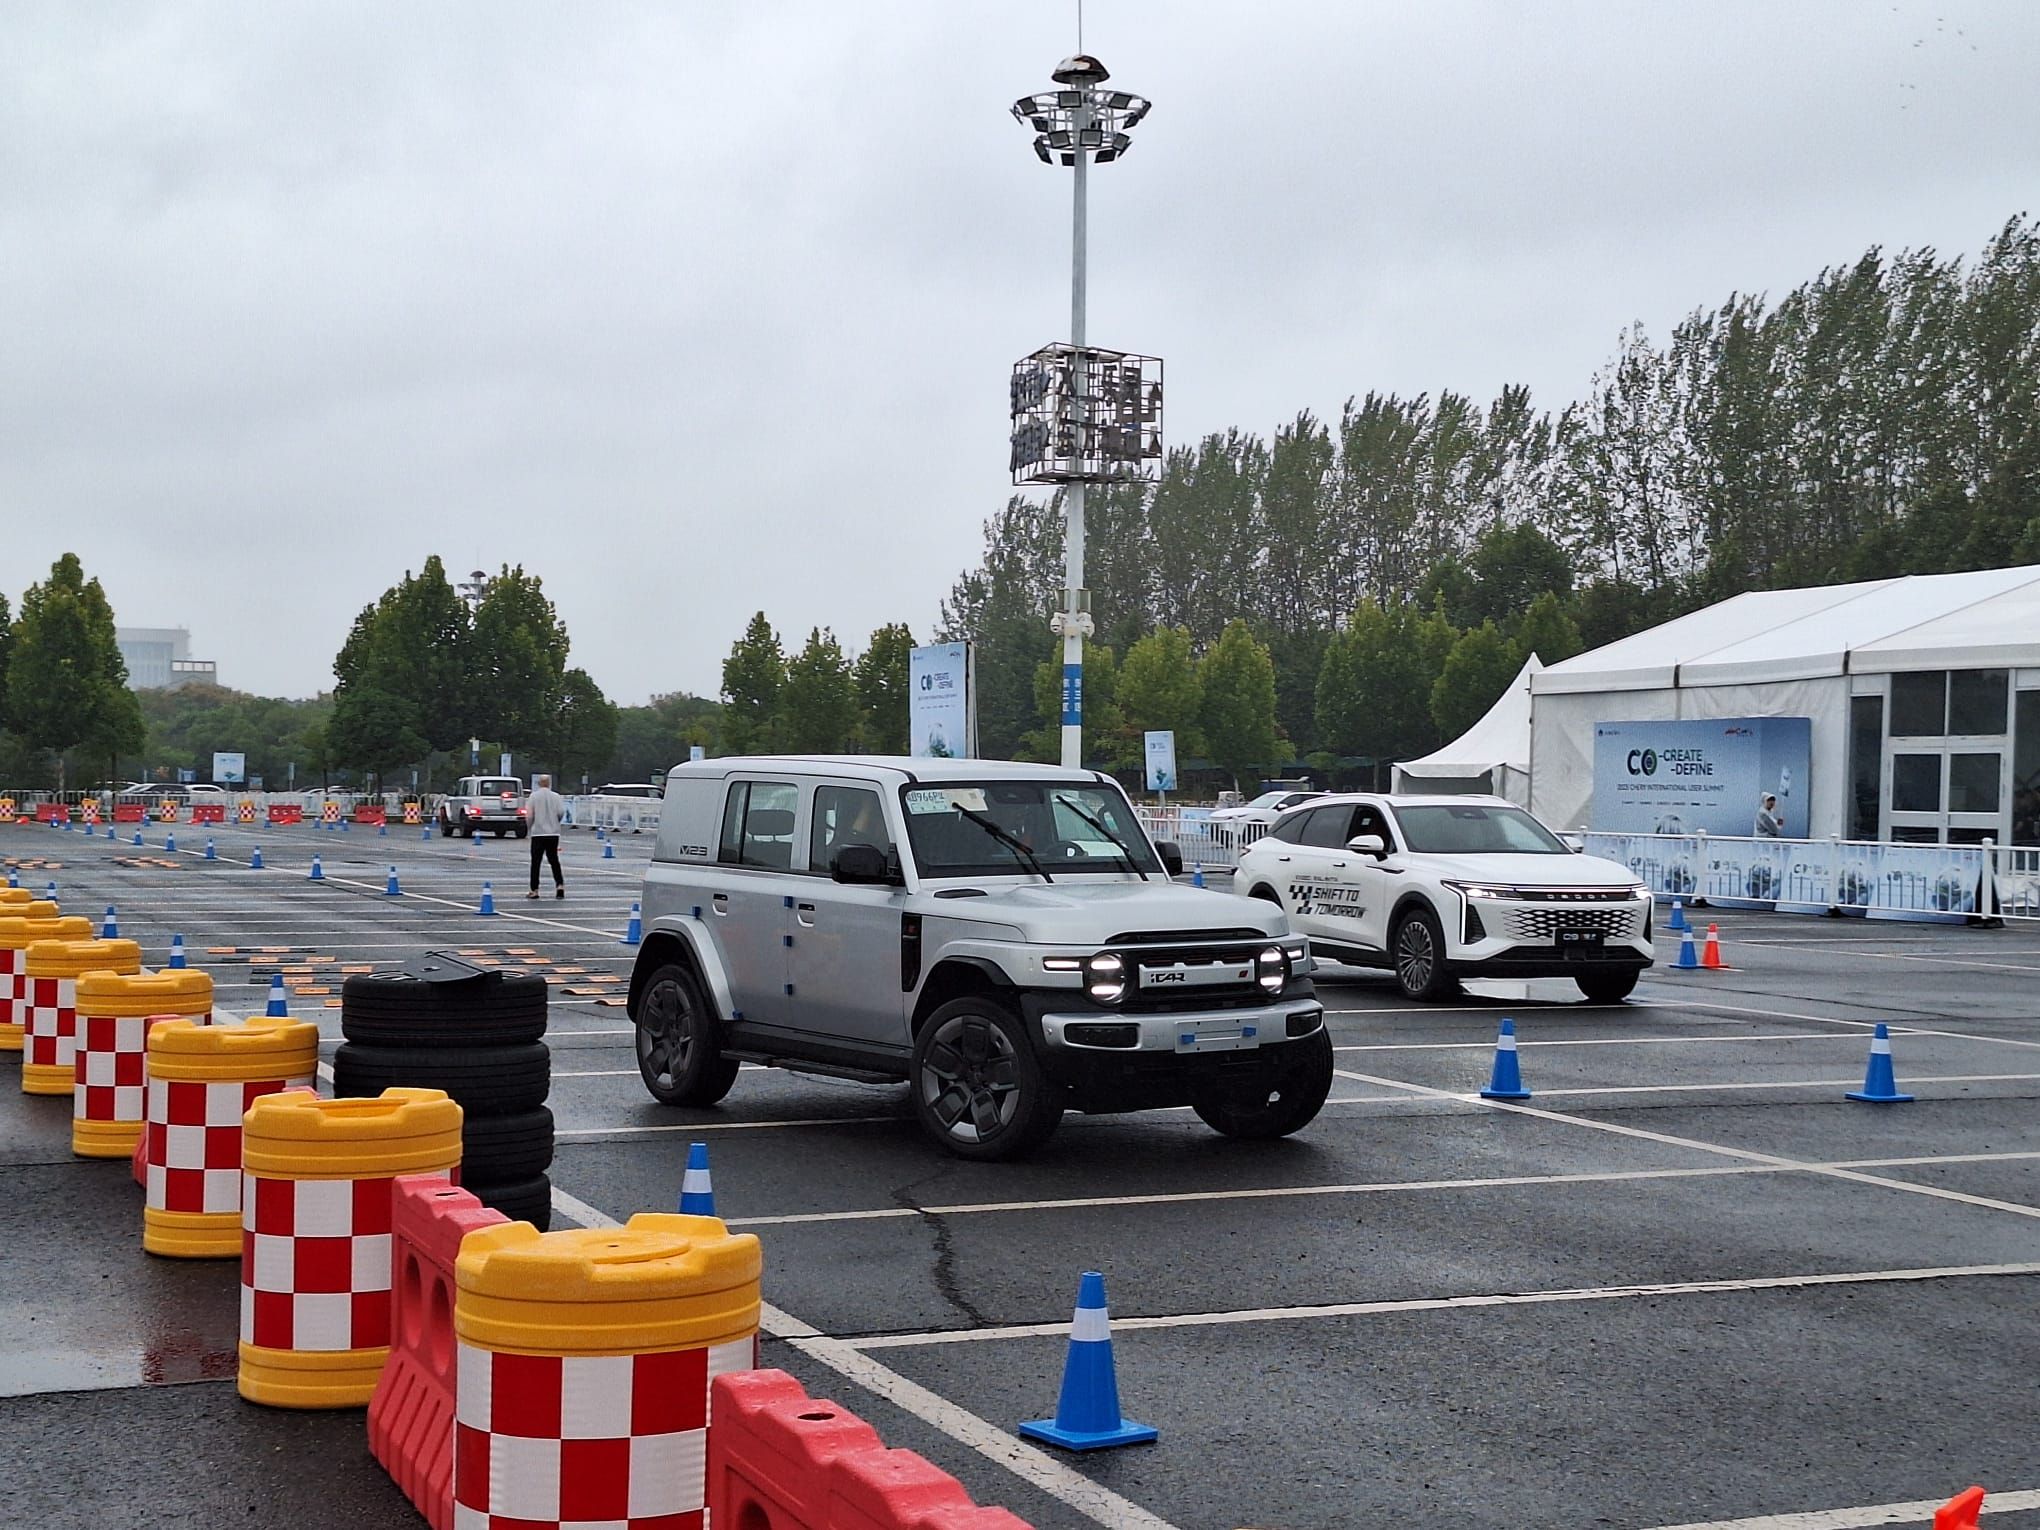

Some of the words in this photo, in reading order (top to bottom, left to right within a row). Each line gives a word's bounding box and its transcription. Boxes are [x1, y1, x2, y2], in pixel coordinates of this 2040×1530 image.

[680, 845, 708, 856] V23
[1312, 887, 1346, 901] SHIFT
[1346, 889, 1361, 902] TO
[1314, 902, 1368, 919] TOMORROW
